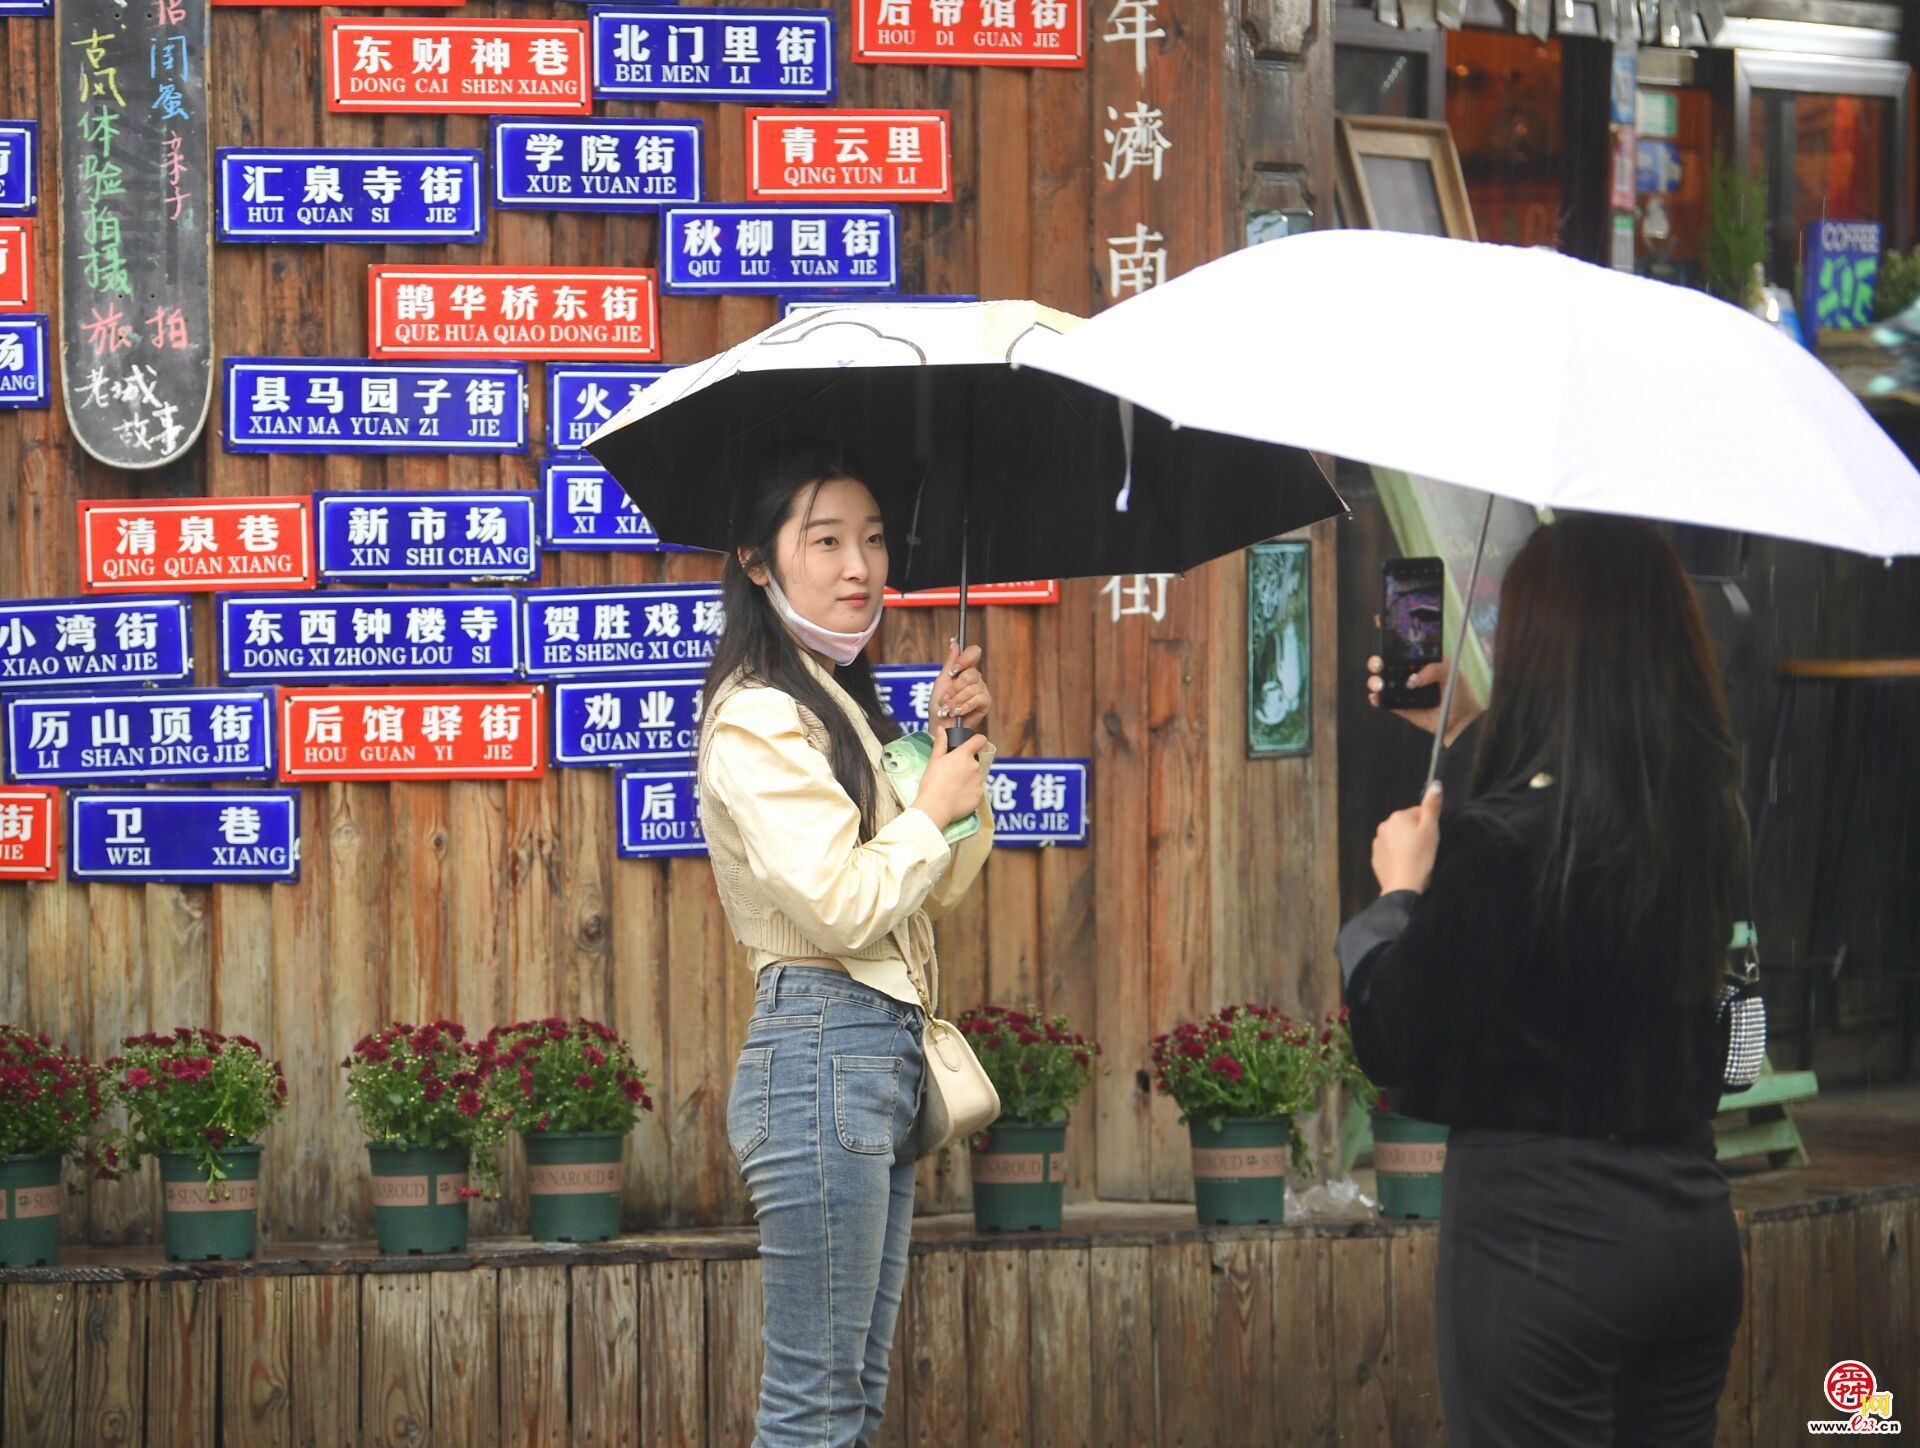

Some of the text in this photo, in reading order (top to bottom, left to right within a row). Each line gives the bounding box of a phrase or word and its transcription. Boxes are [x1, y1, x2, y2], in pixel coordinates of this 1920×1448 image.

[877, 0, 1068, 30] 后帝馆街
[613, 24, 817, 65] 北门里街
[876, 29, 1060, 48] HOU DI GUAN JIE
[352, 35, 569, 76] 东财神巷
[349, 77, 578, 95] DONG CAI SHEN XIANG
[615, 63, 814, 85] BEI MEN LI JIE
[525, 133, 675, 174] 学院街
[780, 126, 923, 165] 青云里
[242, 165, 463, 205] 汇泉寺街
[526, 174, 677, 195] XUE YUAN JIE
[783, 166, 916, 187] QING YUN LI
[247, 206, 457, 225] HUI QUAN SI JIE
[682, 219, 881, 257] 秋柳园街
[688, 258, 878, 278] QIU LIU YUAN JIE
[396, 283, 639, 322] 鹊华桥东街
[80, 302, 188, 356] 旅拍
[394, 323, 642, 345] QUE HUA QIAO DONG JIE
[74, 363, 162, 409] 老城
[250, 376, 506, 417] 县马园子街
[111, 401, 185, 455] 故事
[248, 415, 501, 437] XIAN MA YUAN ZI JIE
[115, 514, 280, 556] 清泉巷
[347, 506, 507, 546] 新市场
[573, 516, 595, 533] XI
[102, 554, 292, 580] QING QUAN XIANG
[350, 546, 529, 566] XIN SHI CHANG
[0, 612, 158, 655] 小湾街
[244, 606, 498, 646] 东西钟楼寺
[544, 601, 726, 643] 贺胜戏场
[2, 651, 158, 677] XIAO WAN JIE
[244, 645, 491, 668] DONG XI ZHONG LOU SI
[544, 640, 719, 663] HE SHENG XI CHA
[28, 704, 253, 750] 历山顶街
[304, 703, 521, 744] 后馆驿街
[304, 744, 513, 763] HOU GUAN YI JIE
[580, 732, 640, 753] QUAN
[645, 730, 673, 749] YE
[38, 743, 250, 769] LI SHAN DING JIE
[105, 806, 261, 845] 卫巷
[640, 823, 685, 841] HOU
[995, 812, 1069, 832] ANG JIE
[106, 847, 286, 866] WEI XIANG
